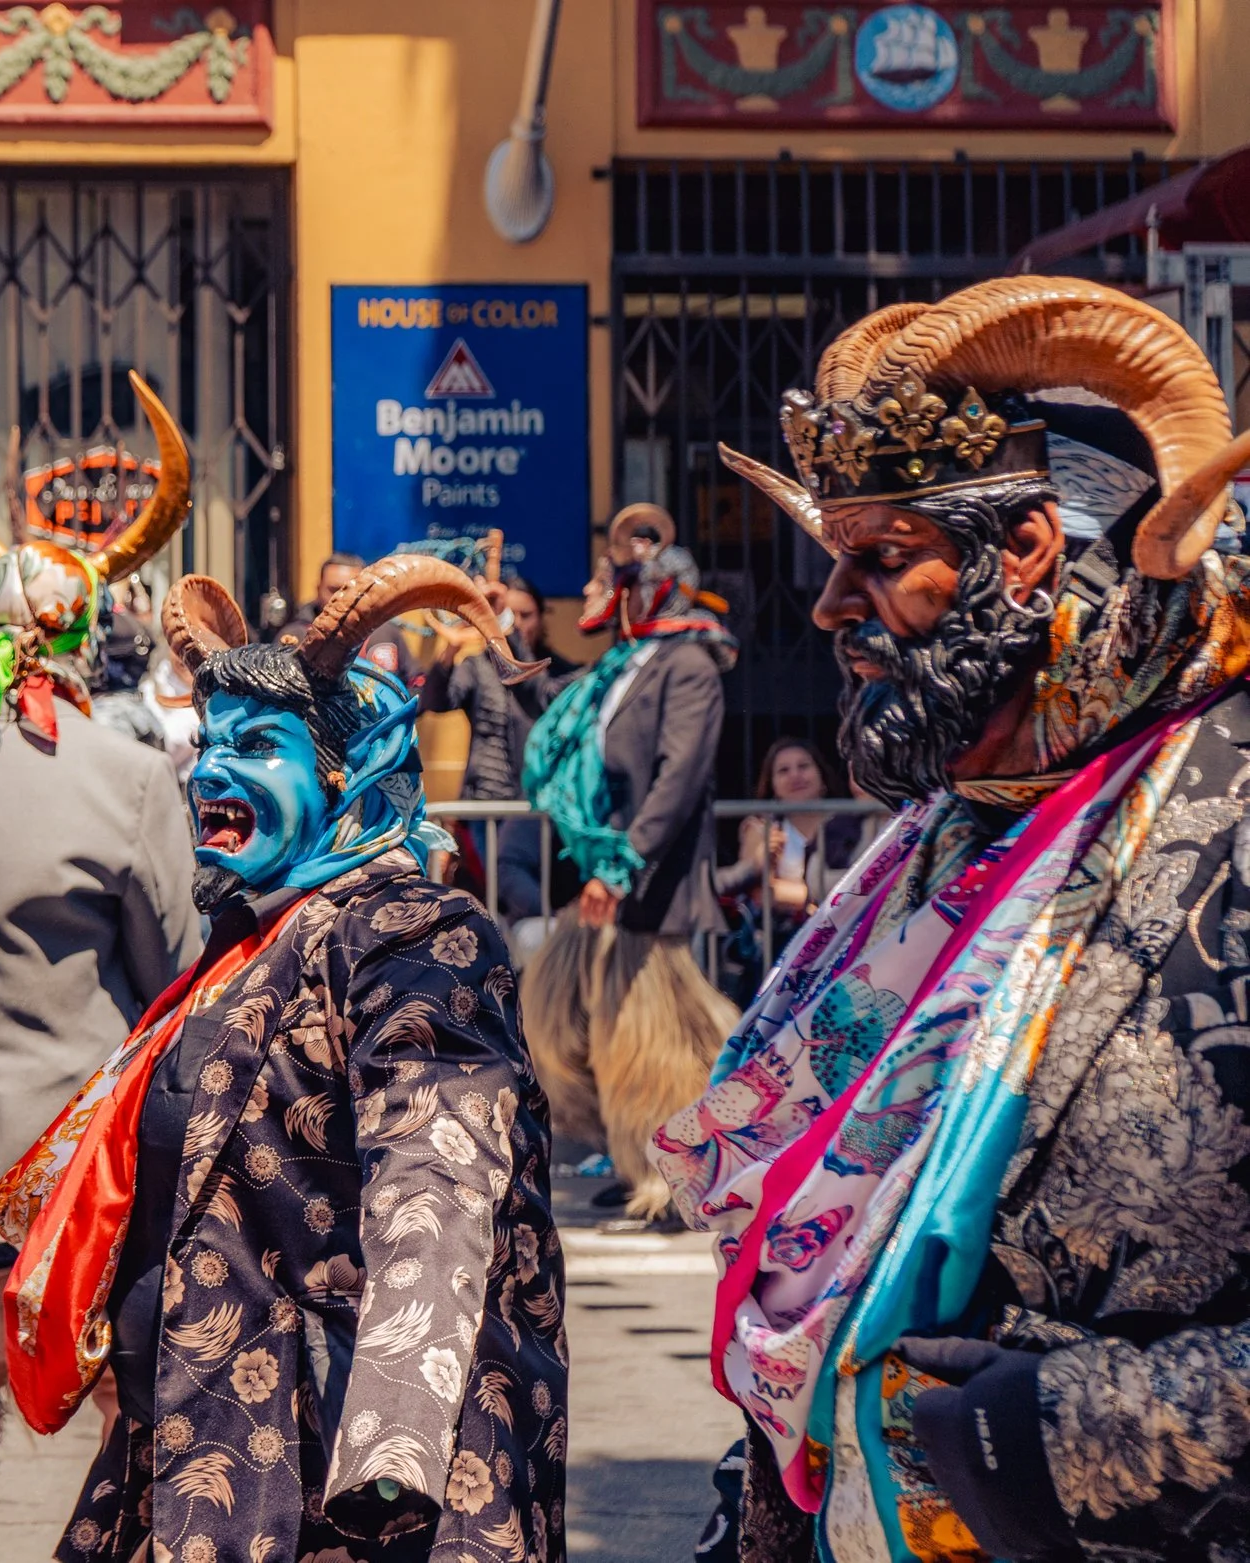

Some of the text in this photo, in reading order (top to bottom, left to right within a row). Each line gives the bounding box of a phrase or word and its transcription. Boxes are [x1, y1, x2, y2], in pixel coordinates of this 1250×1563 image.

[358, 299, 442, 328] HOUSE
[472, 300, 558, 328] COLOR
[376, 399, 544, 443] Benjamin
[393, 437, 519, 475] Moore
[422, 477, 500, 507] Paints
